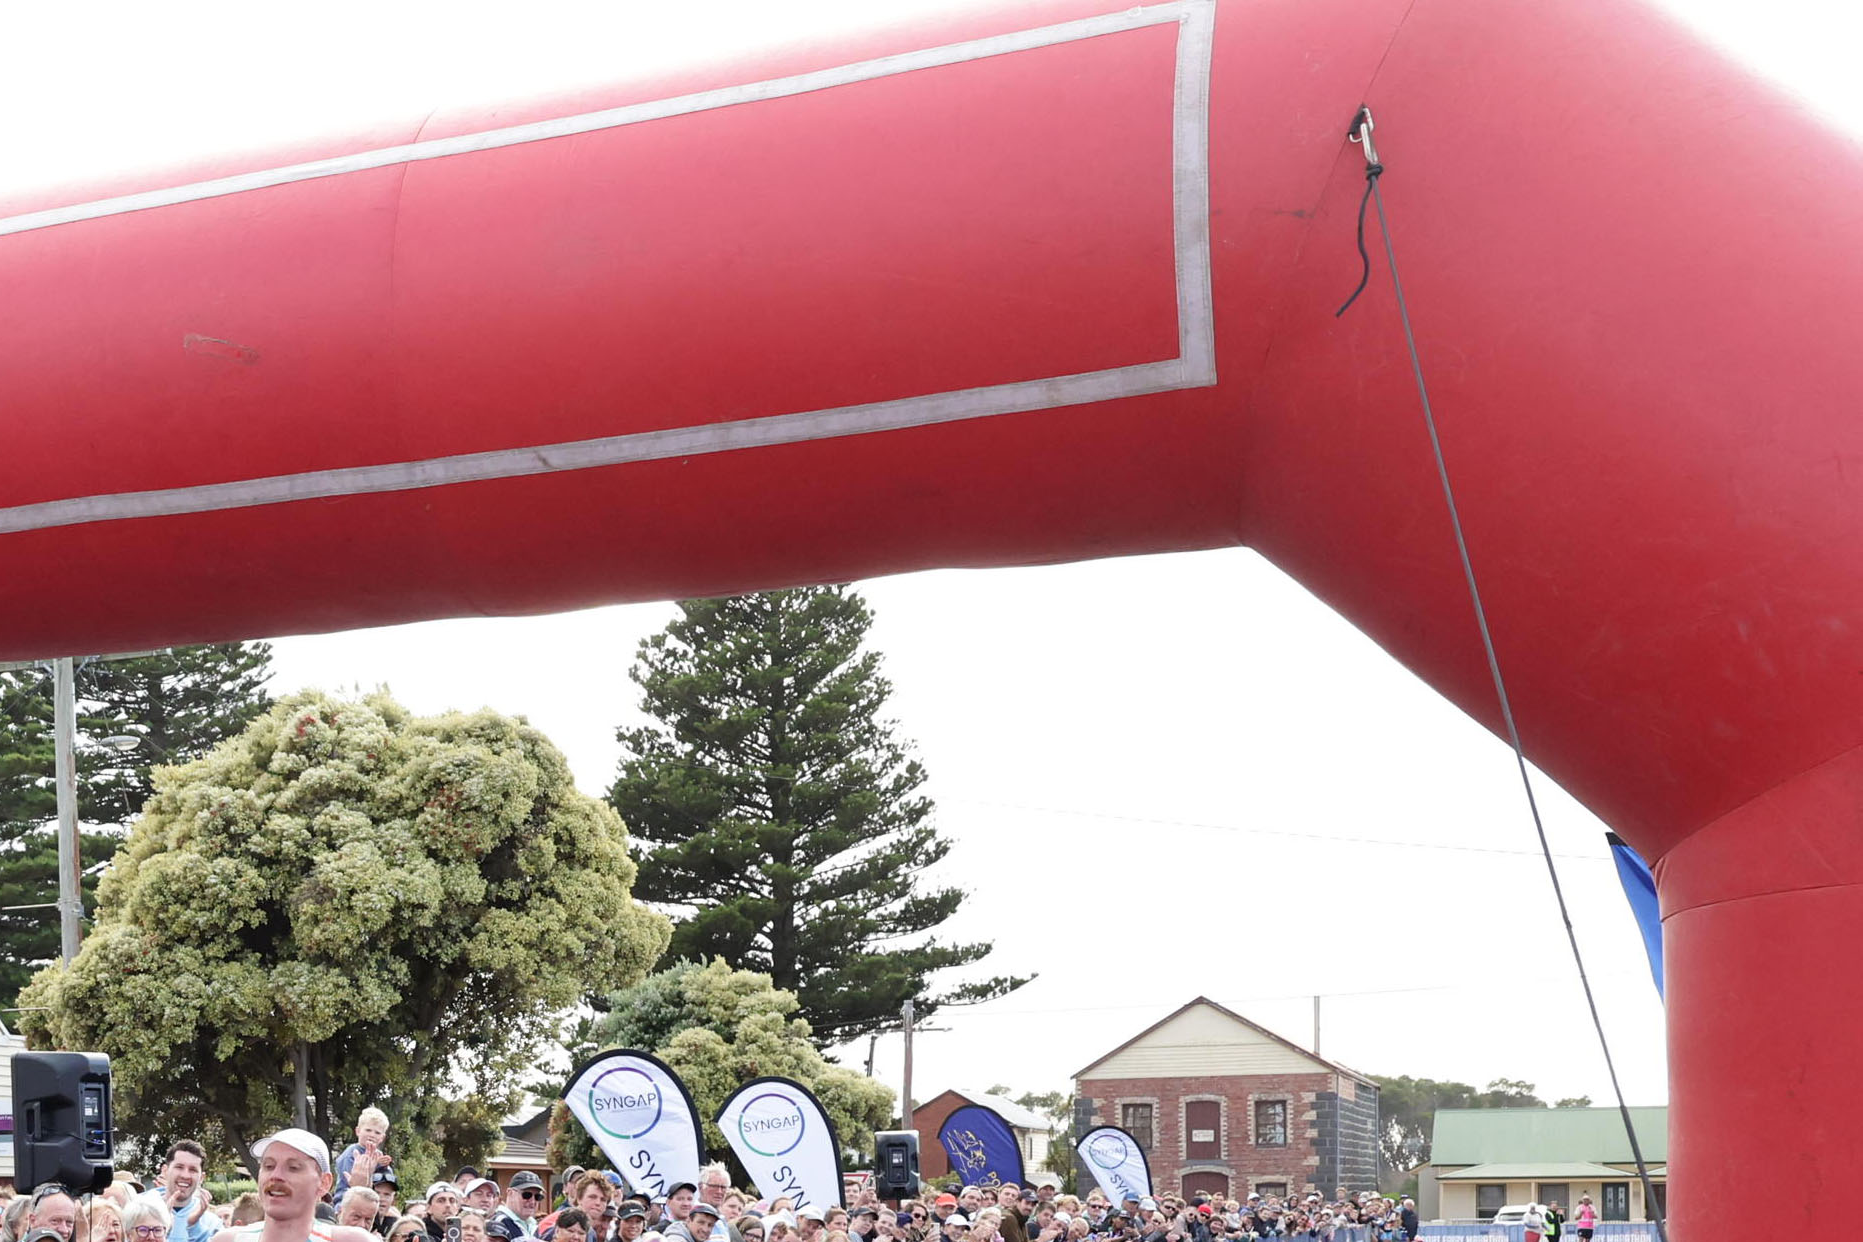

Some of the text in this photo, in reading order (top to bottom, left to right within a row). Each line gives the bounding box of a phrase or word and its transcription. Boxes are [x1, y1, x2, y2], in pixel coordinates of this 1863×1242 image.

[595, 1092, 657, 1111] SYNGAP
[743, 1114, 800, 1132] SYNGAP
[773, 1165, 811, 1212] SYN
